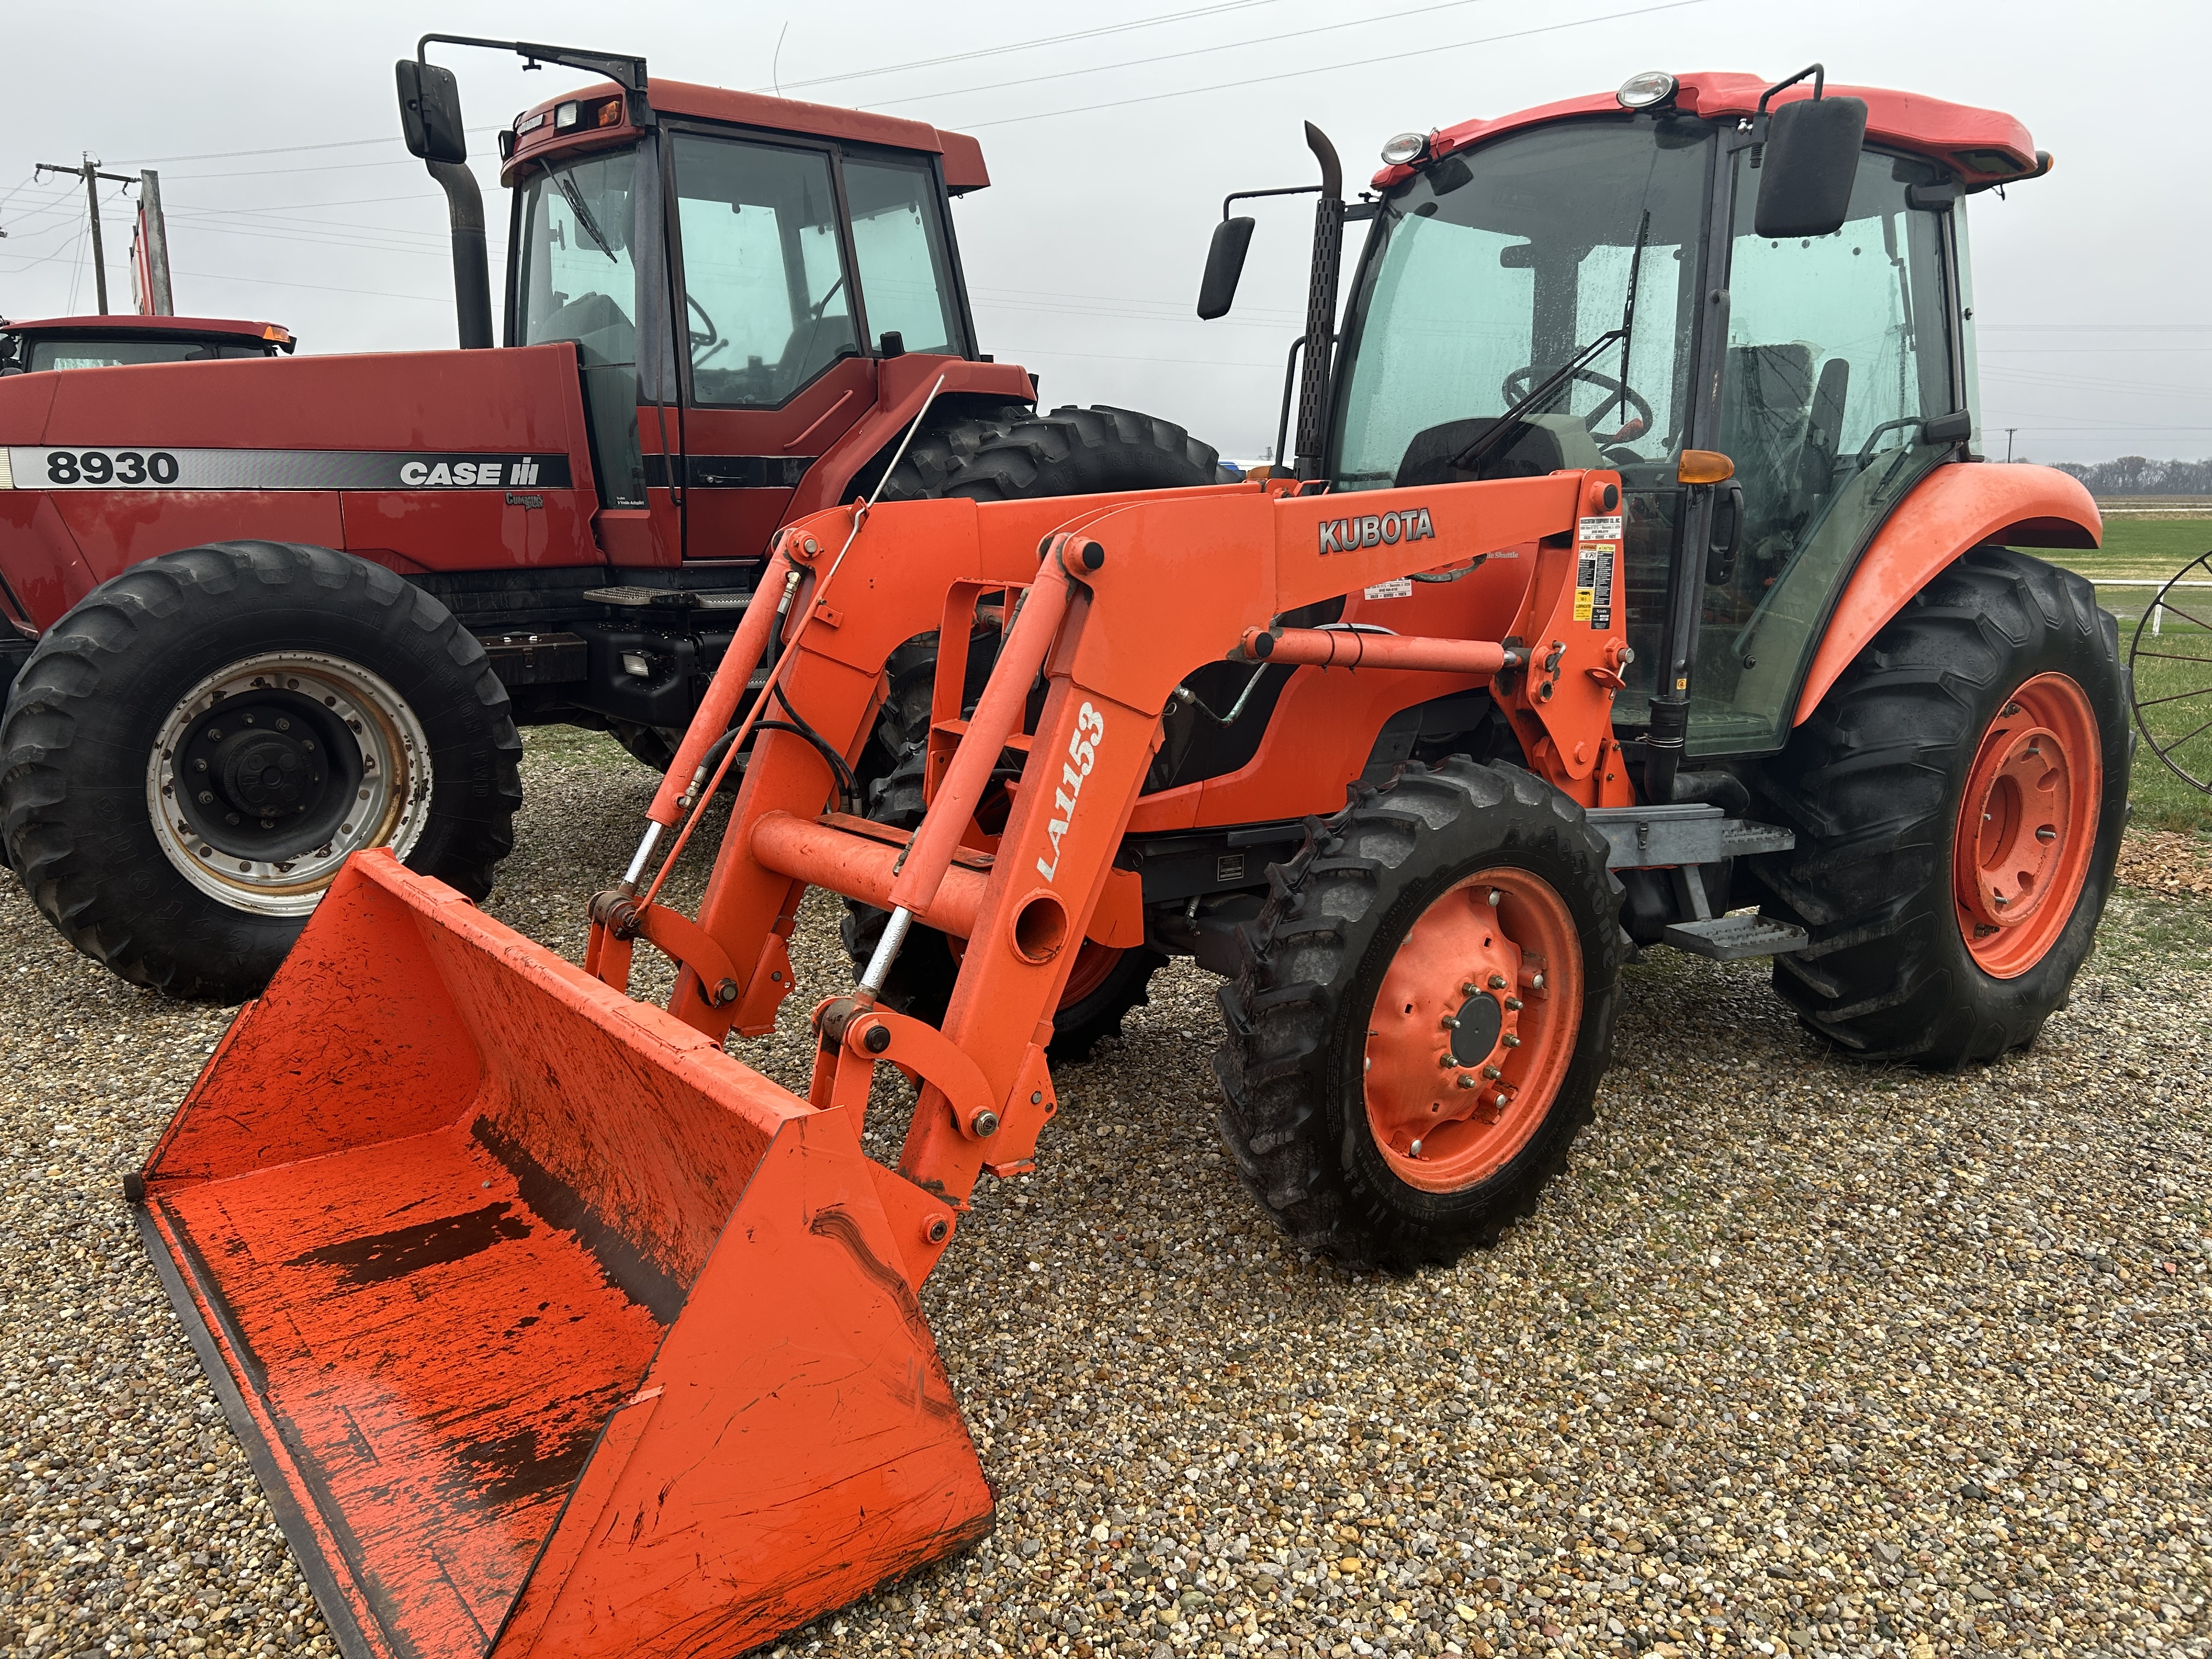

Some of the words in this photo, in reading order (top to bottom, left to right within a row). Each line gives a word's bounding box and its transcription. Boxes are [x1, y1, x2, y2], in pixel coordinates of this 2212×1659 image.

[47, 451, 179, 484] 8930
[400, 461, 503, 486] CASE
[1318, 507, 1435, 555] KUBOTA
[399, 628, 482, 735] TRACTION
[1035, 701, 1104, 883] LA1153
